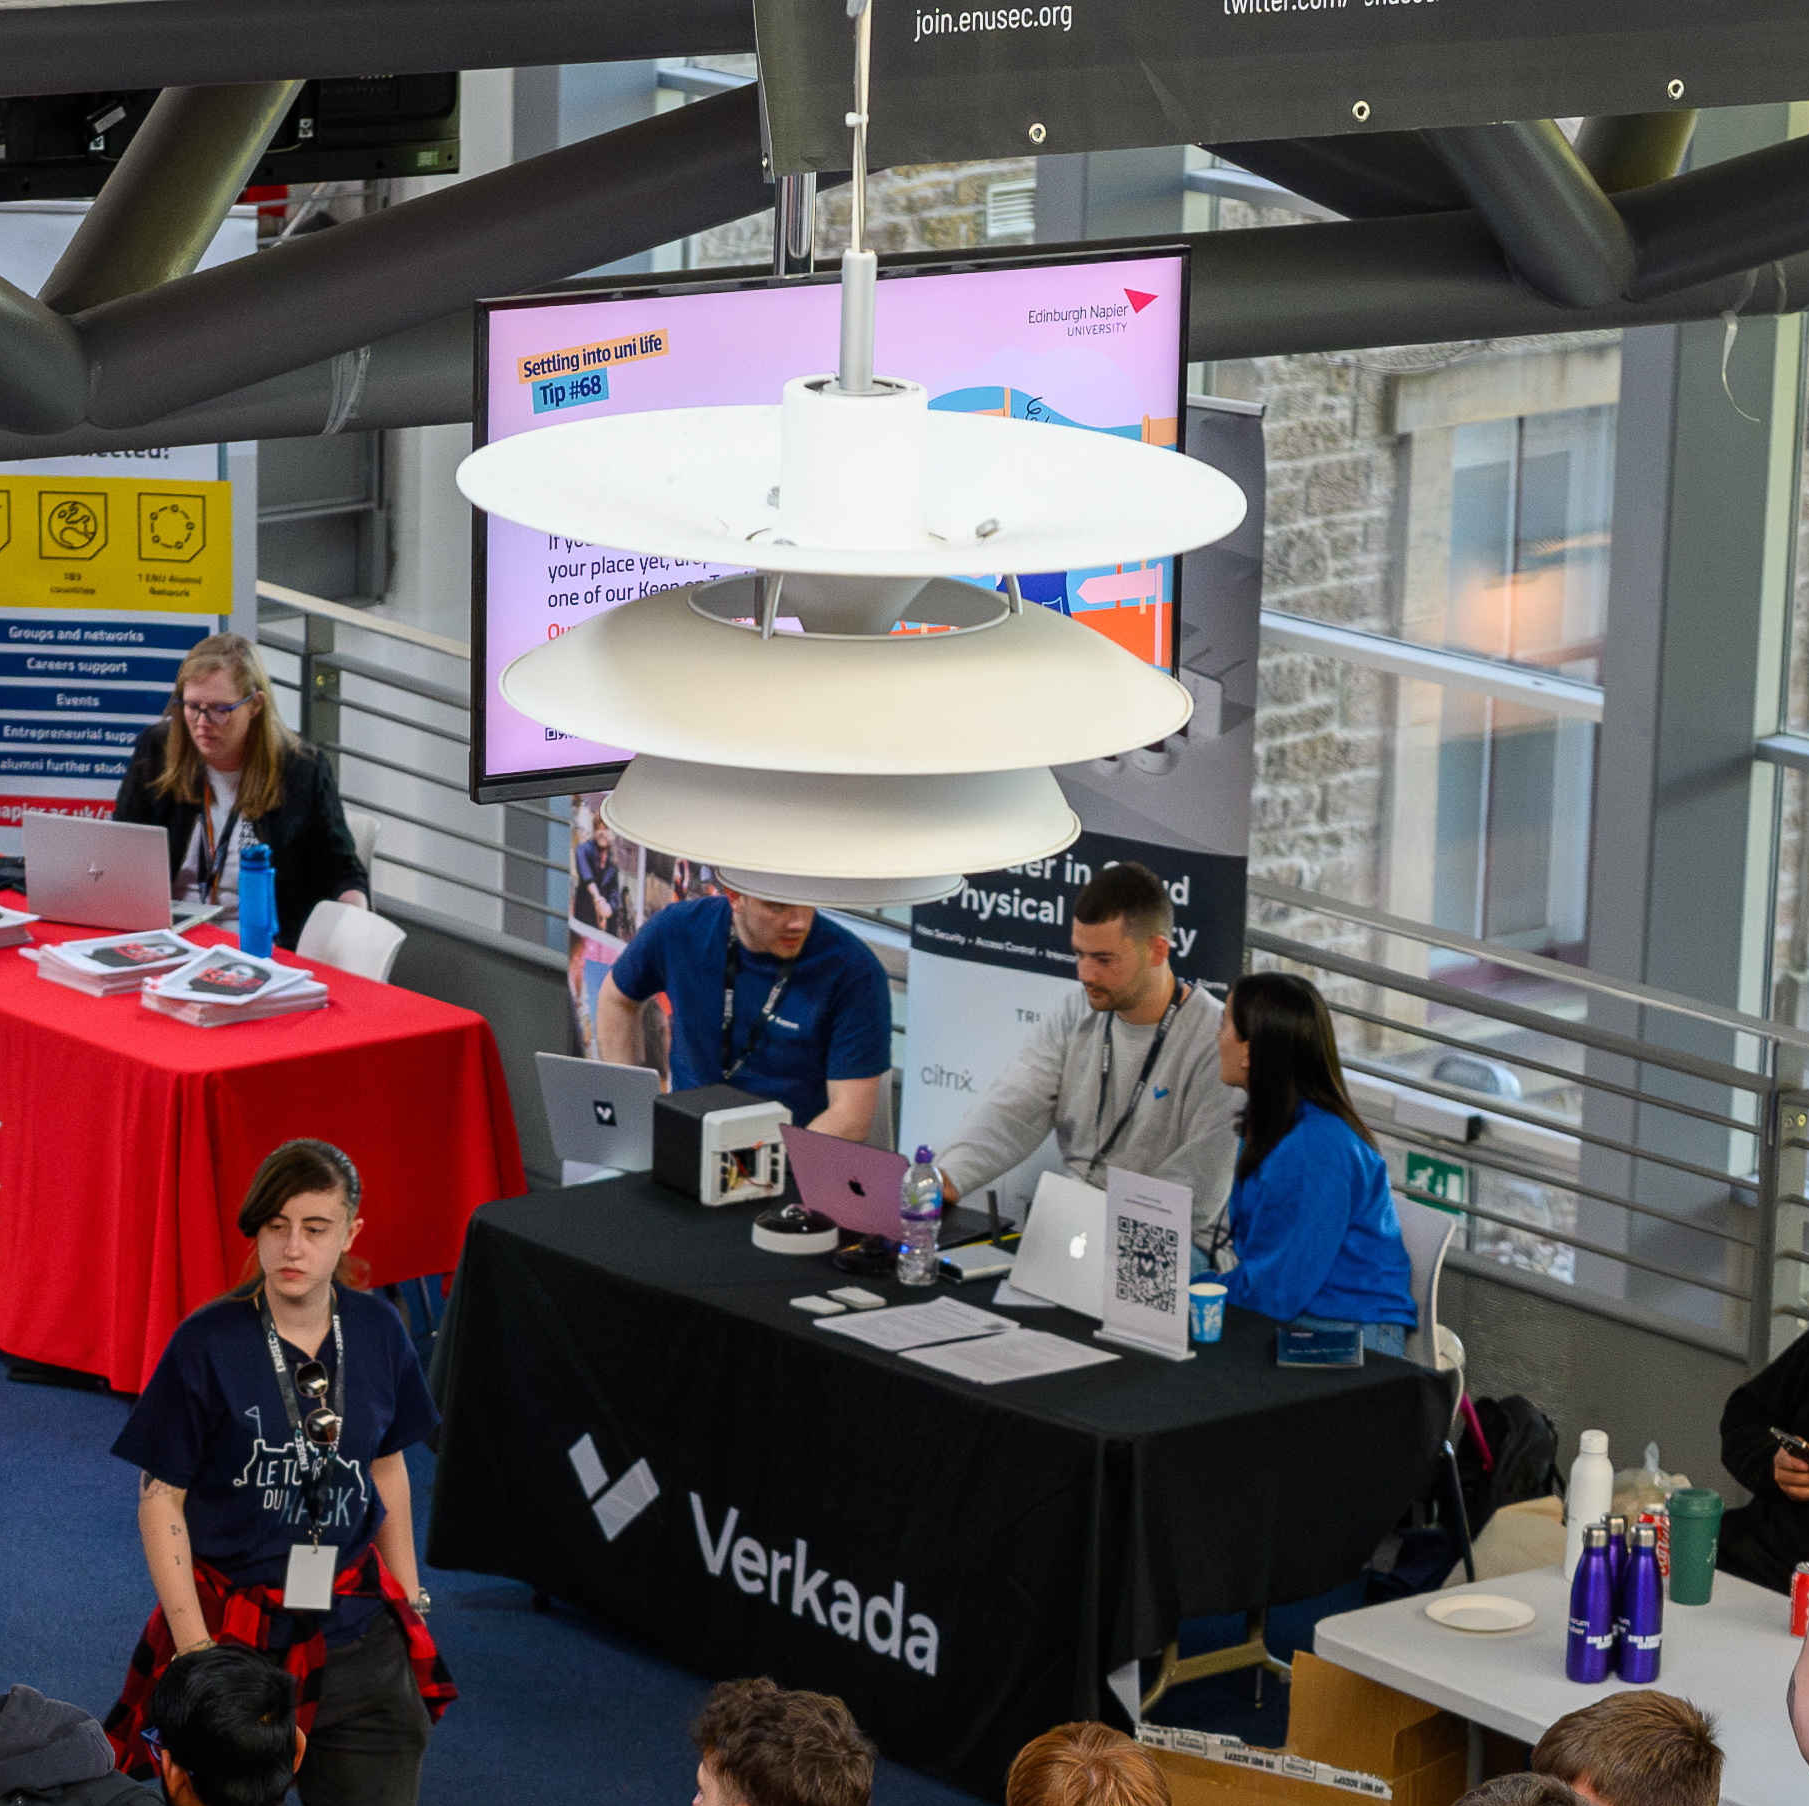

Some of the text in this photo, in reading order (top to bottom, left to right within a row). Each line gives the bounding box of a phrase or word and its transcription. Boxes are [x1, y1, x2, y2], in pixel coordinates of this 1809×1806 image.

[914, 4, 1072, 42] join.enusec.org
[1029, 303, 1128, 324] Edinburgh Napier
[1067, 322, 1128, 337] UNIVERSITY
[523, 334, 662, 378] Settling into uni life
[540, 375, 602, 407] Tip #68
[548, 560, 587, 583] your
[591, 557, 635, 580] place
[548, 583, 634, 608] one of our
[9, 626, 145, 642] Groups and networks
[27, 657, 128, 675] Careers support
[56, 693, 100, 707] Events
[3, 725, 103, 741] Entrepreneurial
[0, 758, 44, 771] alumni
[46, 759, 91, 774] further
[257, 1460, 278, 1487] LE
[263, 1489, 284, 1510] DU
[689, 1490, 940, 1677] Verkada
